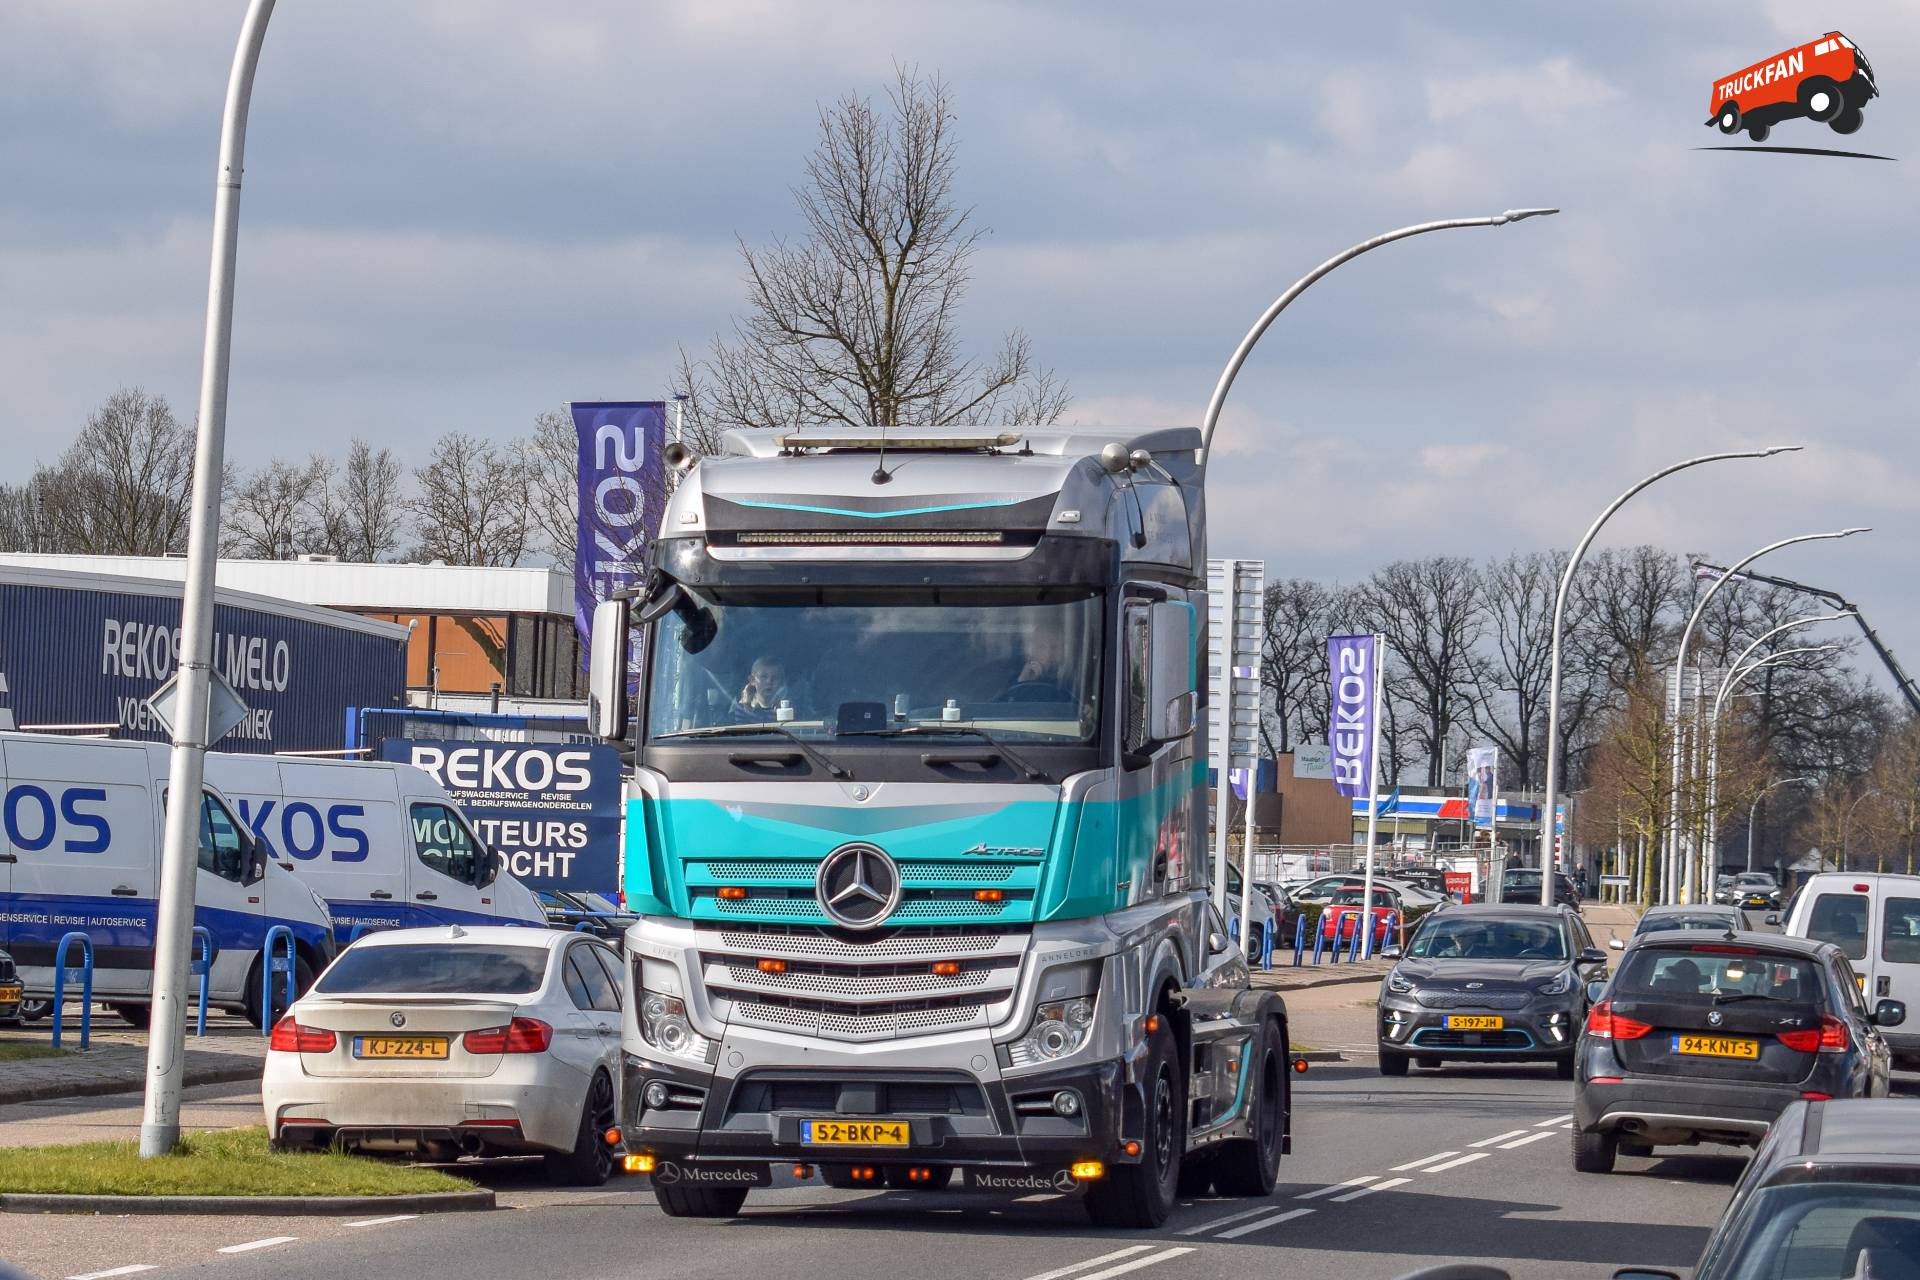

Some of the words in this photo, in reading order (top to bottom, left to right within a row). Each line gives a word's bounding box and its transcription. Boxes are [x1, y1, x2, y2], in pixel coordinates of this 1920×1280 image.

[411, 746, 591, 791] REKOS
[472, 800, 592, 810] BEDRIJFSWAGENONDERDELEN
[4, 784, 111, 852] OS
[54, 915, 85, 925] REVISIE
[91, 917, 147, 927] AUTOSERVICE
[330, 916, 351, 925] EVISIE
[1454, 1017, 1496, 1027] S-197-JH
[369, 1039, 440, 1055] KJ-224-L
[1684, 1037, 1753, 1056] 94-KNT-5
[817, 1124, 901, 1141] 52-BKP-4
[683, 1166, 758, 1182] Mercedes
[975, 1173, 1051, 1189] Mercedes
